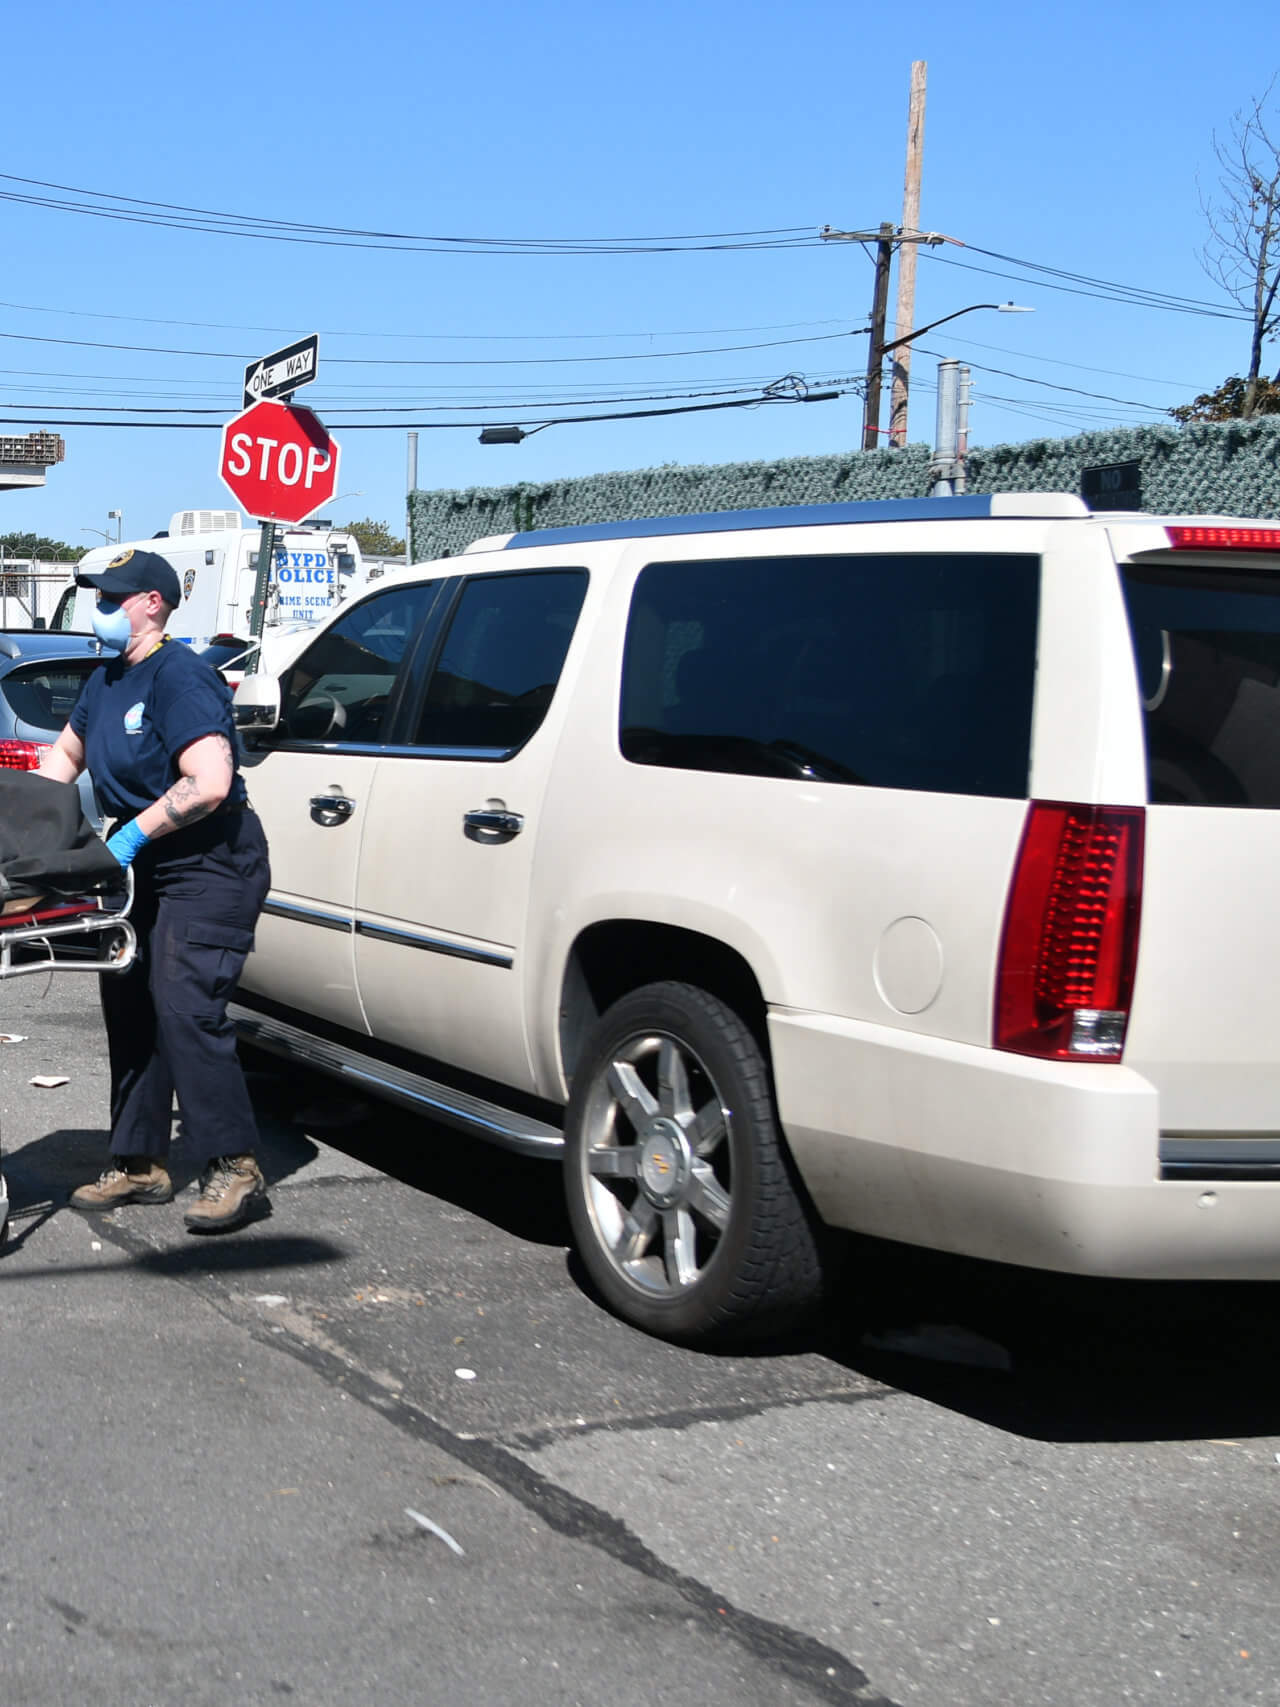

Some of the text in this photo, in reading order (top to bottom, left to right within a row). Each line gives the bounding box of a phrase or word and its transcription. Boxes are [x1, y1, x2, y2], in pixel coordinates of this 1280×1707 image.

[253, 351, 311, 392] ONE WAY
[228, 432, 332, 489] STOP
[1100, 470, 1122, 490] NO
[268, 568, 335, 583] OLICE
[305, 596, 332, 607] SCENE
[292, 609, 314, 619] UNIT
